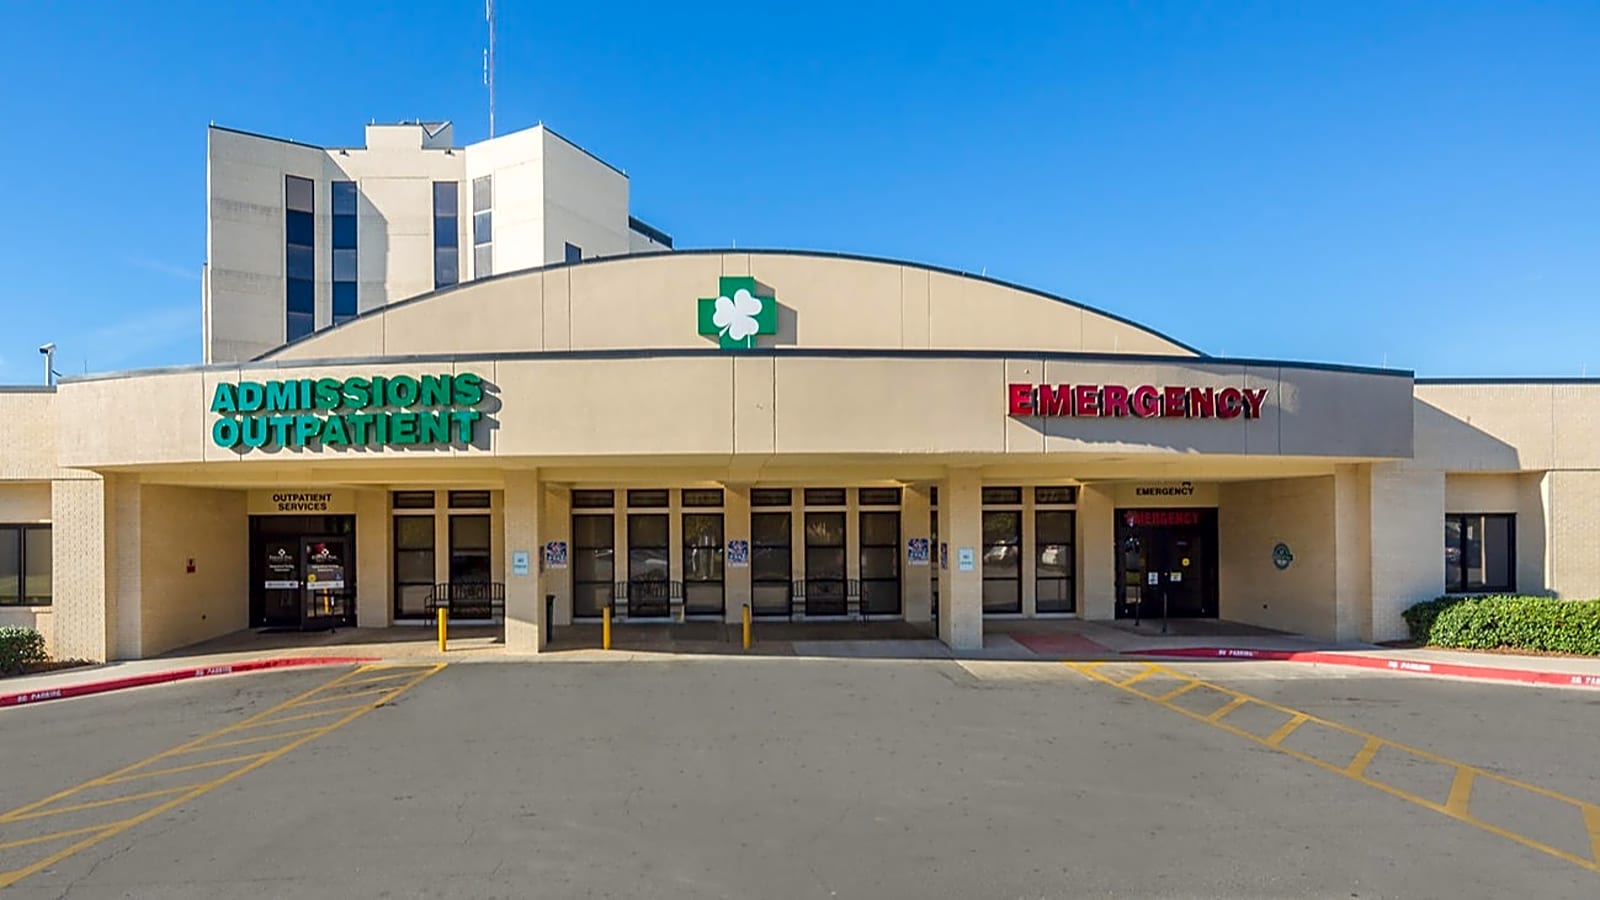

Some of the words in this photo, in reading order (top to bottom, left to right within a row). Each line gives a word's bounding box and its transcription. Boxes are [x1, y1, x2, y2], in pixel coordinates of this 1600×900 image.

[210, 373, 482, 412] ADMISSIONS
[1008, 383, 1268, 418] EMERGENCY
[212, 411, 479, 448] OUTPATIENT
[272, 493, 332, 502] OUTPATIENT
[1136, 487, 1194, 496] EMERGENCY
[278, 502, 327, 511] SERVICES
